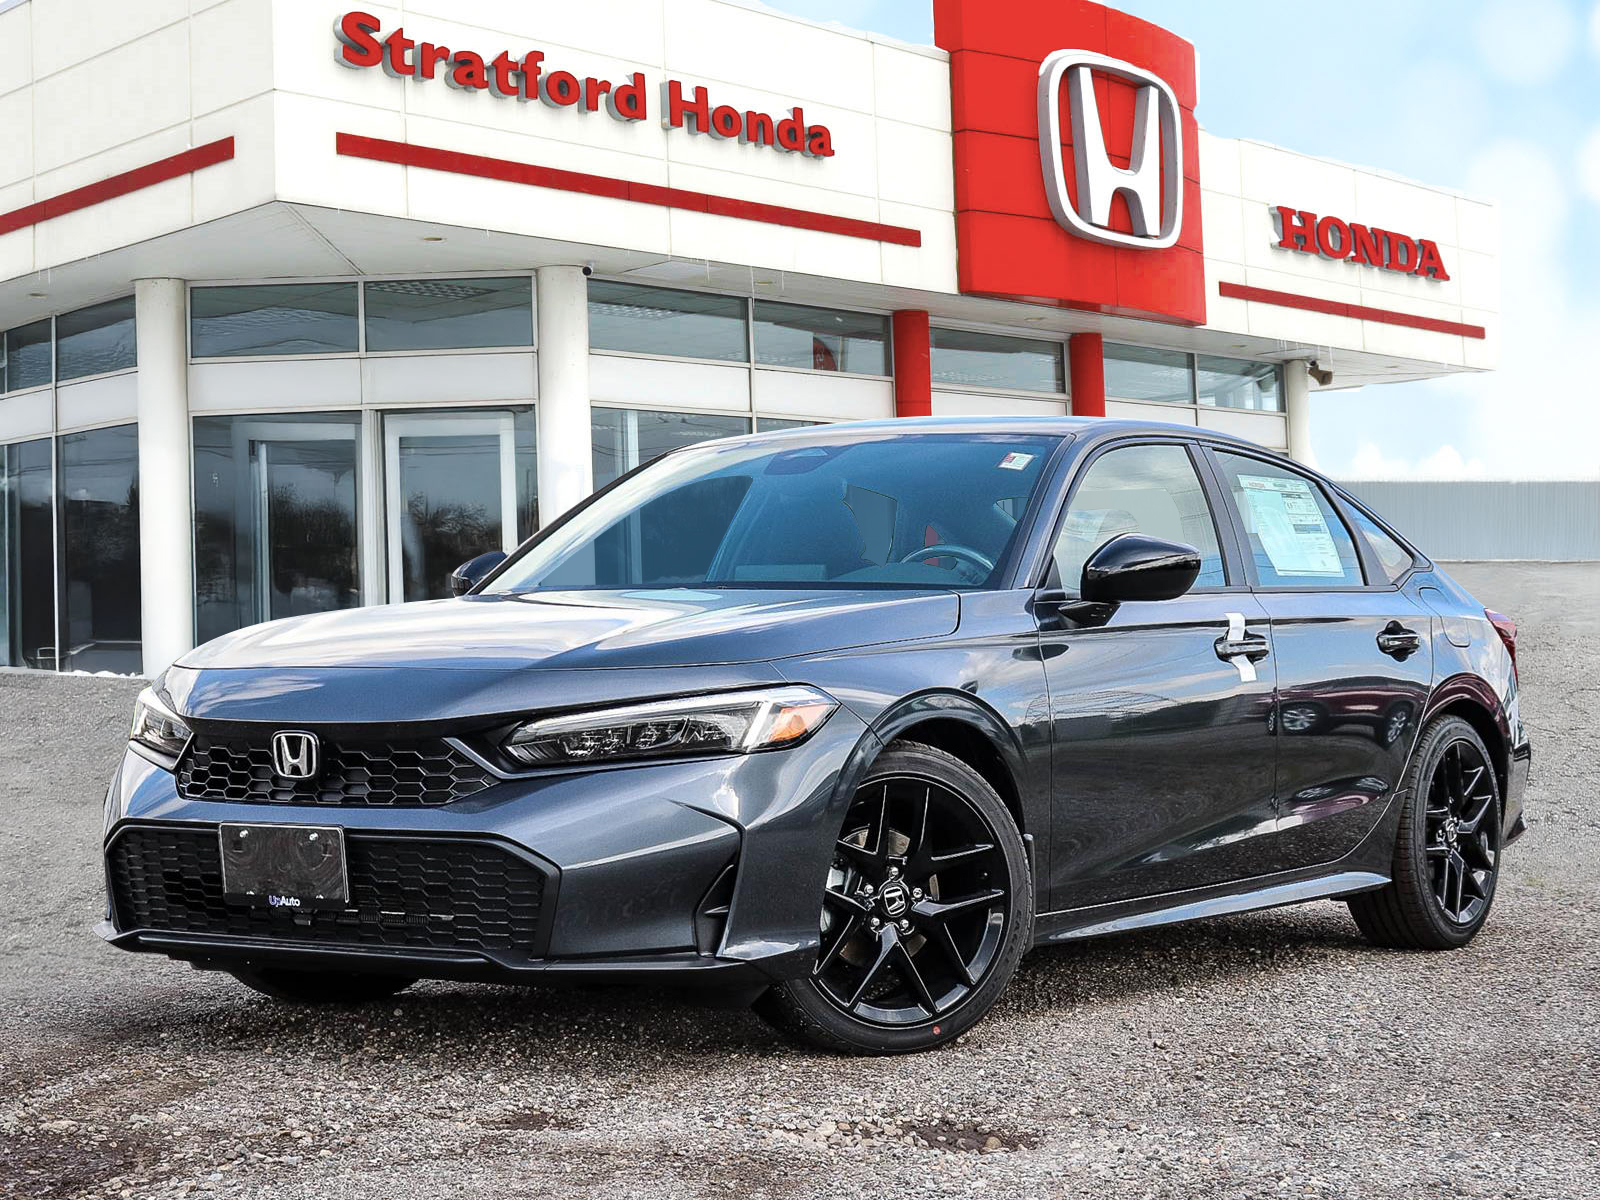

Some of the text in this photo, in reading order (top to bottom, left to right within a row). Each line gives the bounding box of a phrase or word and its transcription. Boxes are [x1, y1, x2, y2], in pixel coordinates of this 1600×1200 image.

[338, 11, 835, 157] Stratford Honda
[1270, 205, 1451, 281] HONDA
[268, 894, 301, 908] UpAuto
